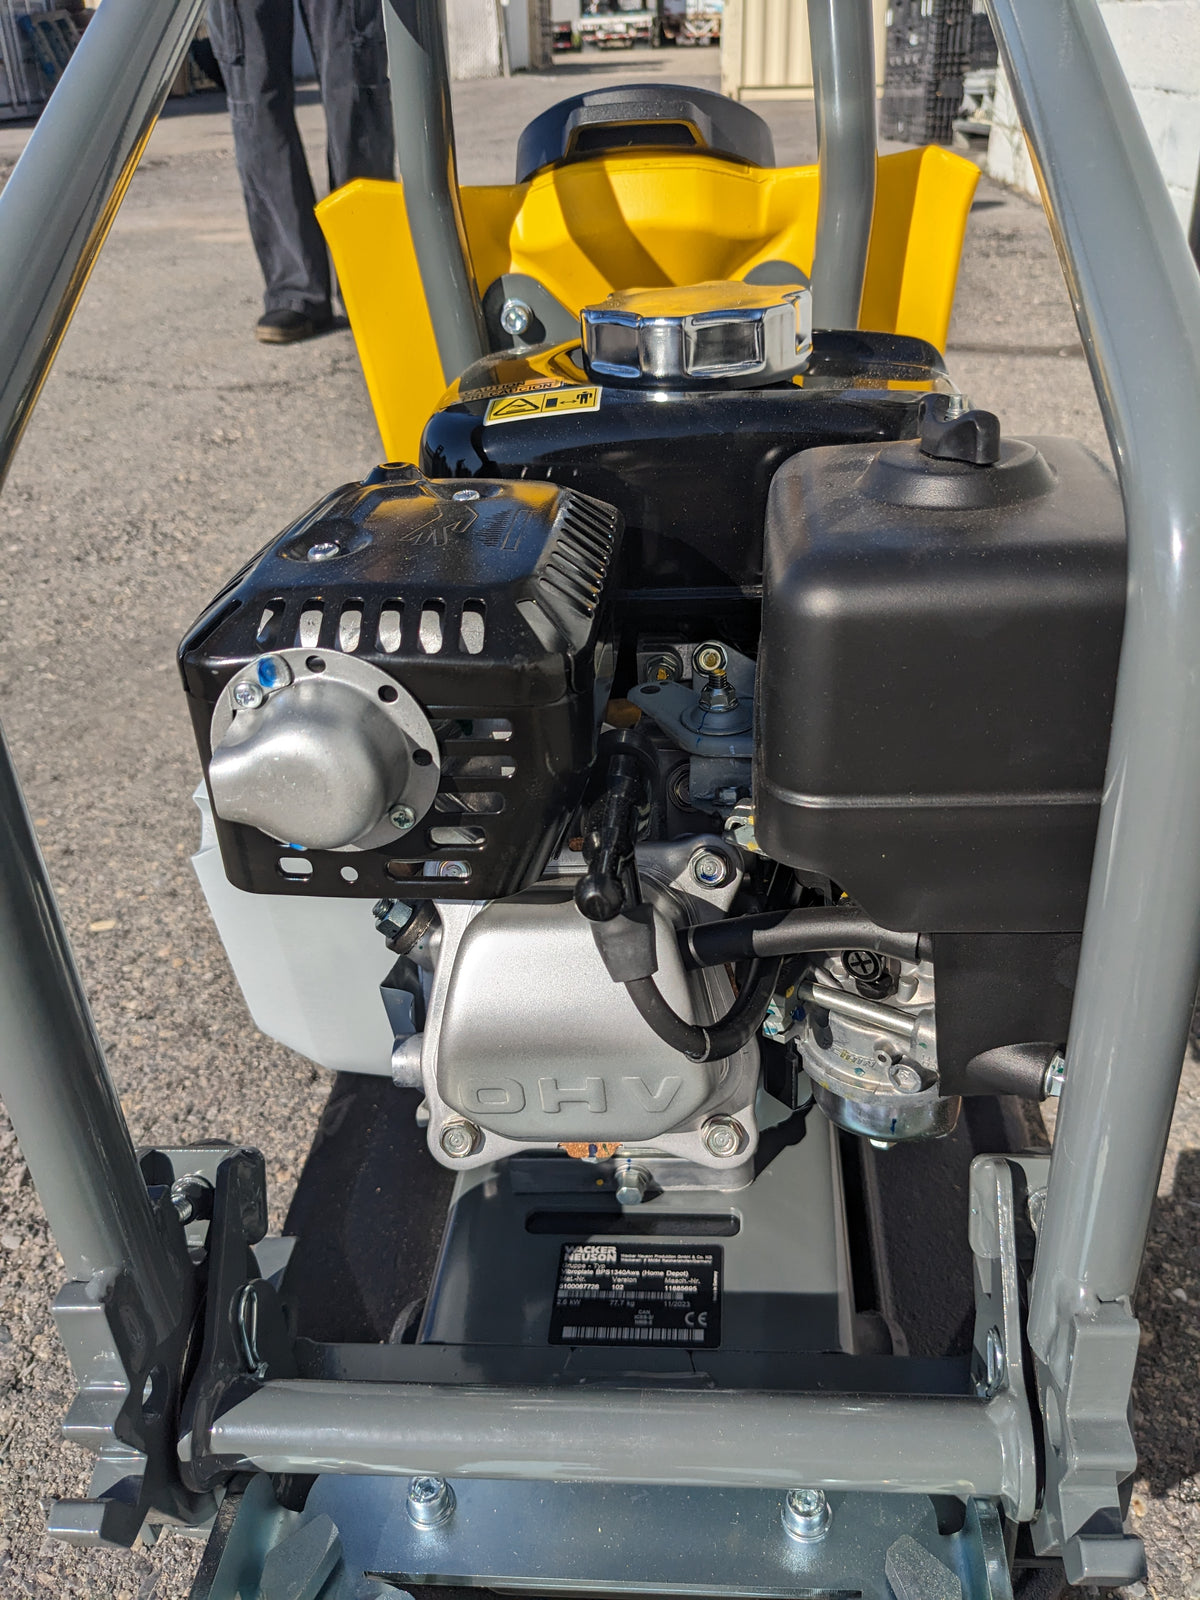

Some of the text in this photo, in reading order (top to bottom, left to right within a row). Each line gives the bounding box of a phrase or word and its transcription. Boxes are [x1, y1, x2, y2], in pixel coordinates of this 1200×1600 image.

[458, 1075, 683, 1115] OHV
[564, 1245, 617, 1254] WACKER
[564, 1253, 617, 1262] NEUSON
[561, 1268, 594, 1276] Vibroplate
[666, 1270, 689, 1278] Depot)
